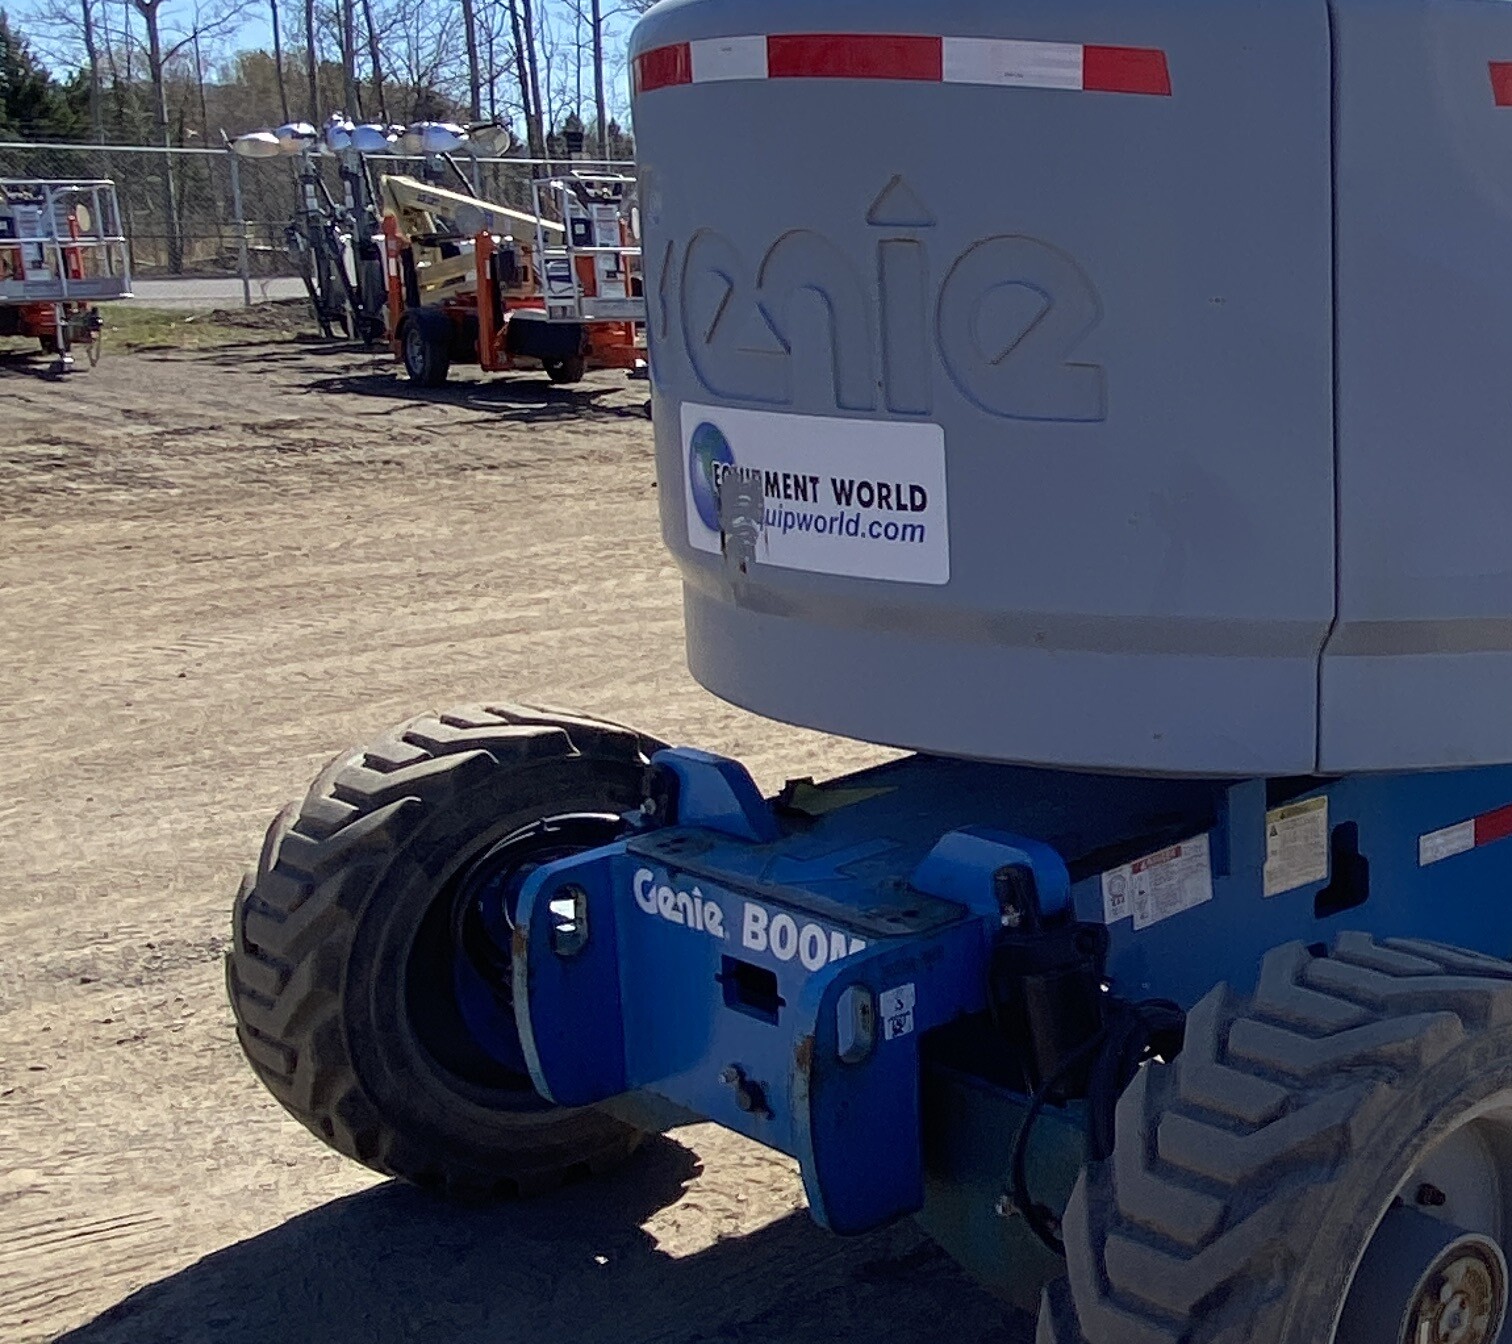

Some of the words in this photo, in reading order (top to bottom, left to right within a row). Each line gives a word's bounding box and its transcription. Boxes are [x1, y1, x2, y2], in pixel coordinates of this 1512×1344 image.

[831, 477, 928, 513] WORLD
[757, 503, 925, 544] uipworld.com
[633, 867, 725, 939] Genie
